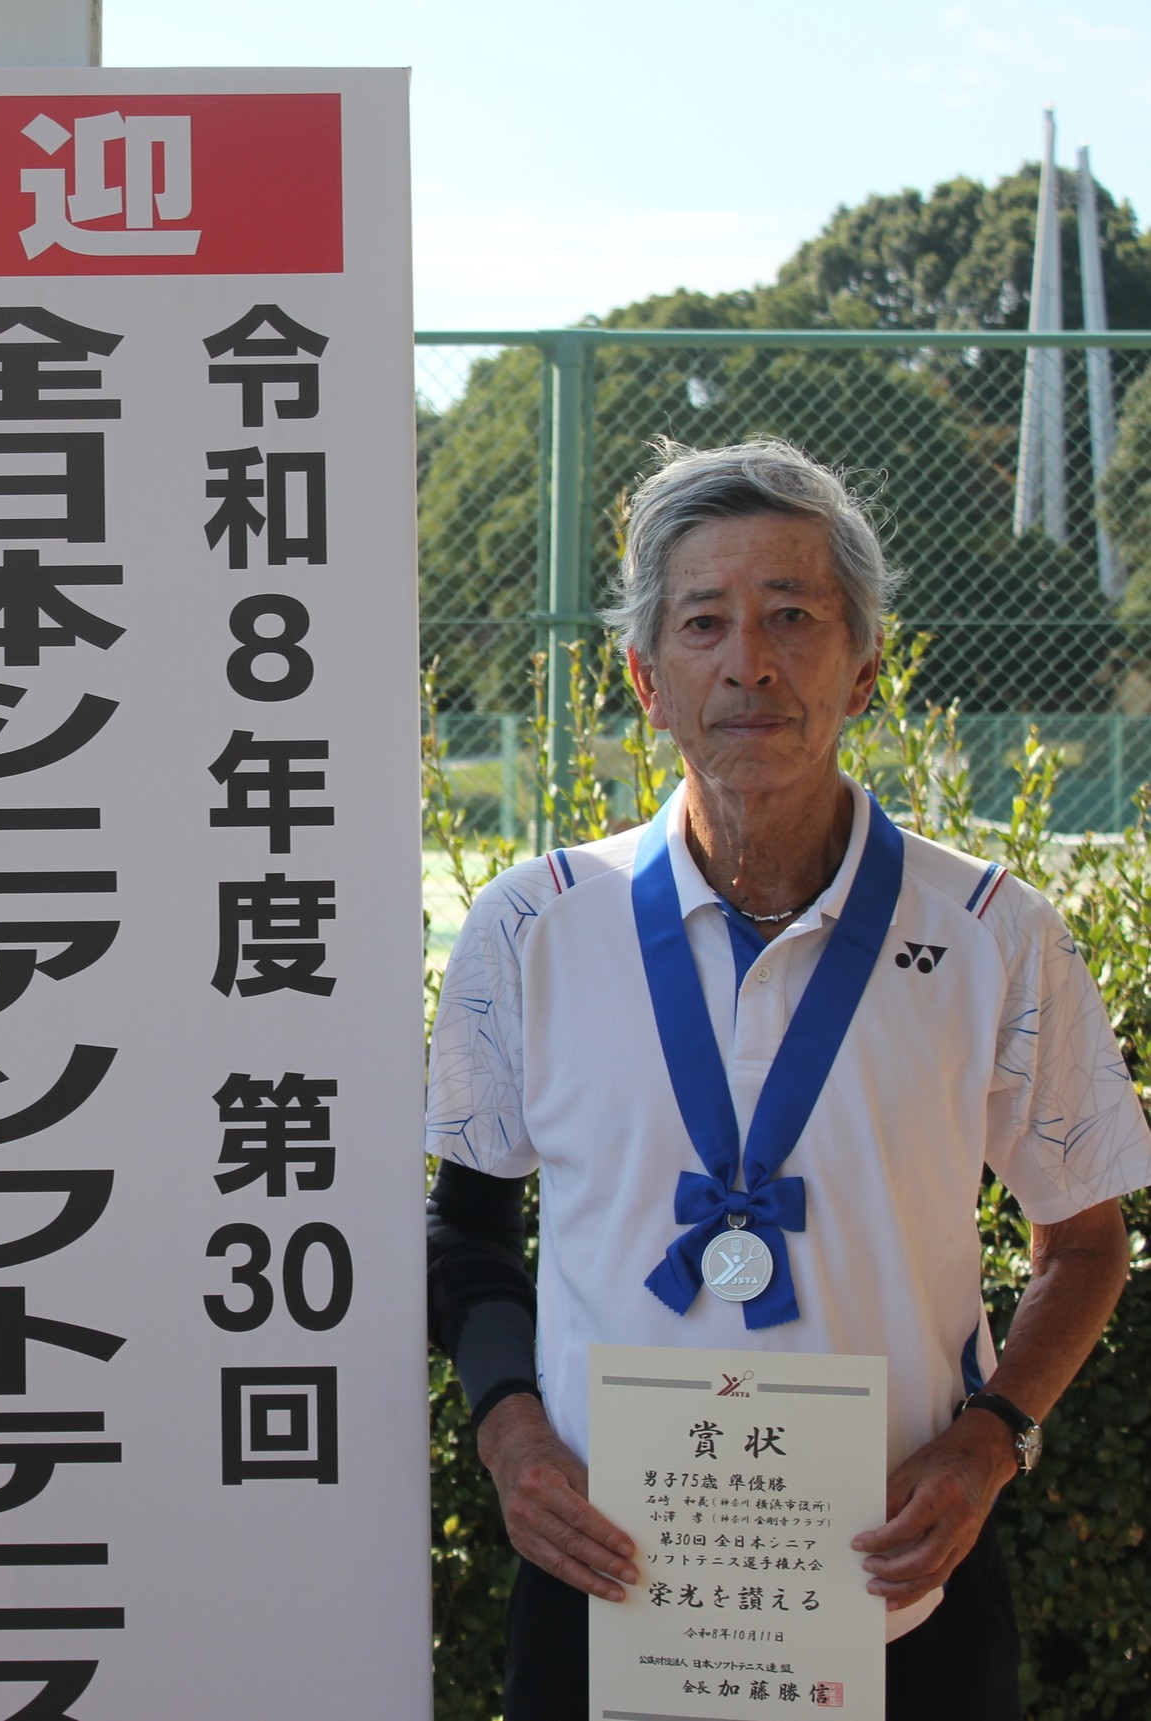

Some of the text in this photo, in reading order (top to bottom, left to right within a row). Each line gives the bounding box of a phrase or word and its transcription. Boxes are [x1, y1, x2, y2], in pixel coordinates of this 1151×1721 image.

[202, 303, 354, 1486] 令和8年度 第30回
[731, 1276, 758, 1285] JSTA
[729, 1390, 750, 1398] JSTA
[689, 1420, 787, 1460] 賞状
[643, 1470, 787, 1493] 男子75歳 準優勝
[650, 1510, 676, 1523] 小澤
[692, 1511, 703, 1524] 孝
[660, 1530, 816, 1550] 第30回 全日本シニア
[647, 1554, 824, 1571] ソフトテニス選手権大会
[648, 1581, 820, 1611] 栄光を讃える
[683, 1627, 784, 1643] 令和8年10月11日
[693, 1659, 795, 1674] 日本ソフトテニス連盟
[682, 1679, 712, 1695] 会長
[718, 1679, 830, 1704] 加藤勝信
